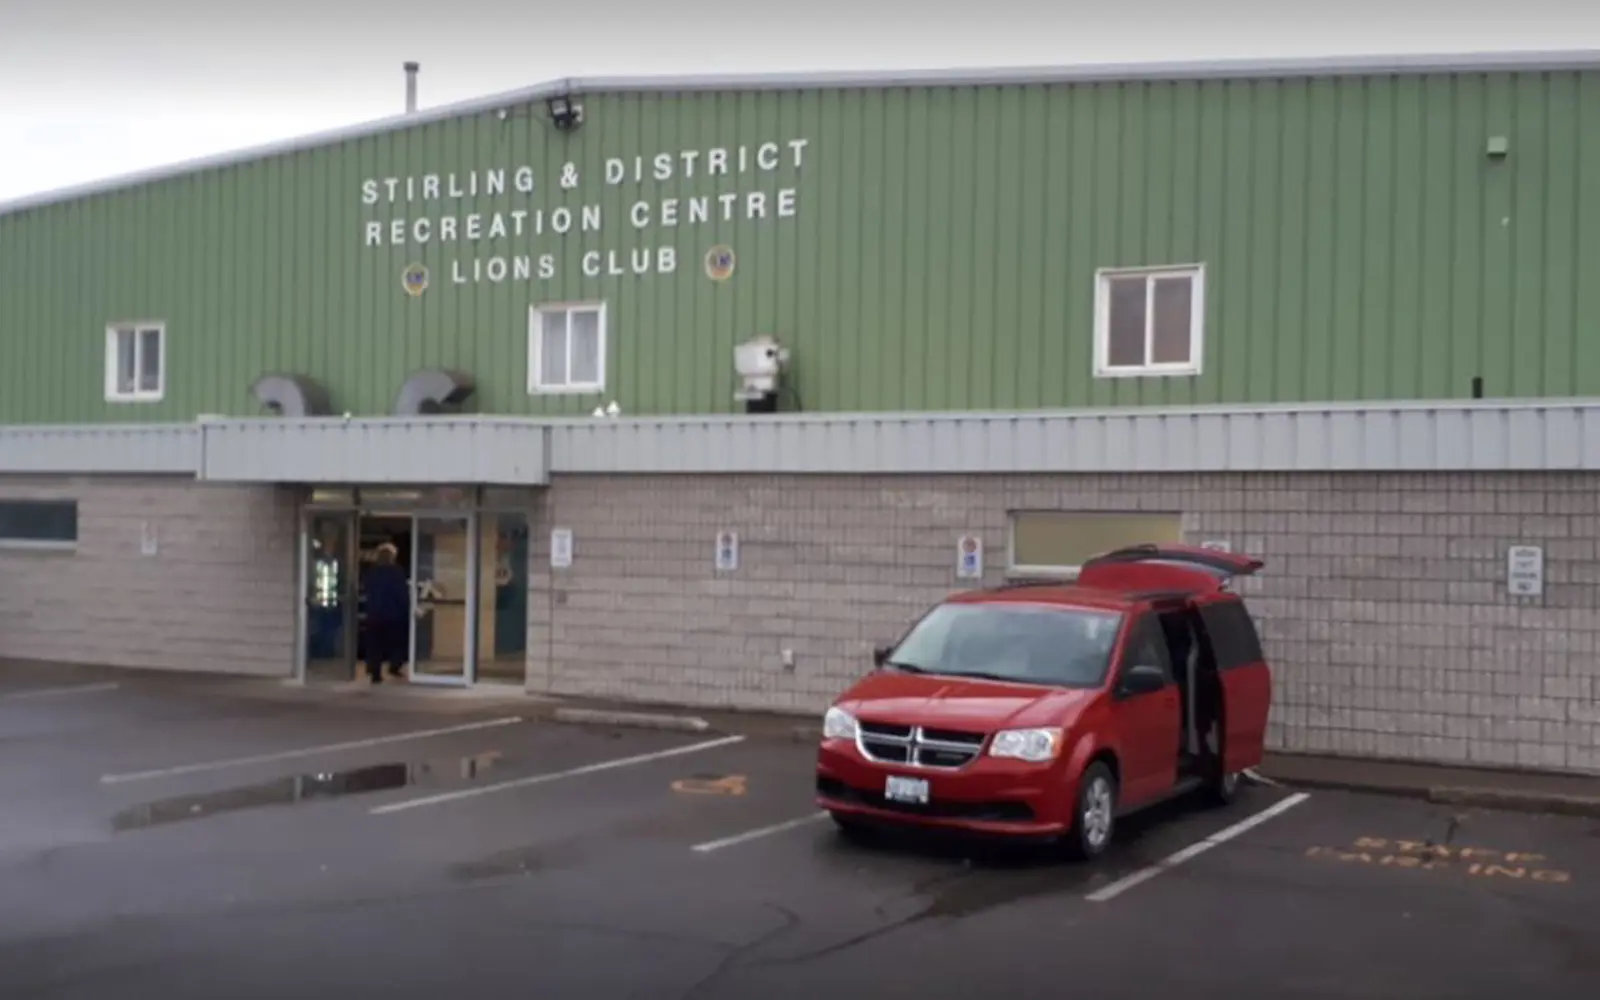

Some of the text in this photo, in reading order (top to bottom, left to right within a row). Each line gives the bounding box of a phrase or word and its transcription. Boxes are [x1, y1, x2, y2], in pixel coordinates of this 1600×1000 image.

[362, 139, 808, 204] STIRLING & DISTRICT
[366, 189, 796, 246] RECREATION CENTRE
[452, 254, 554, 283] LIONS
[582, 247, 676, 276] CLUB
